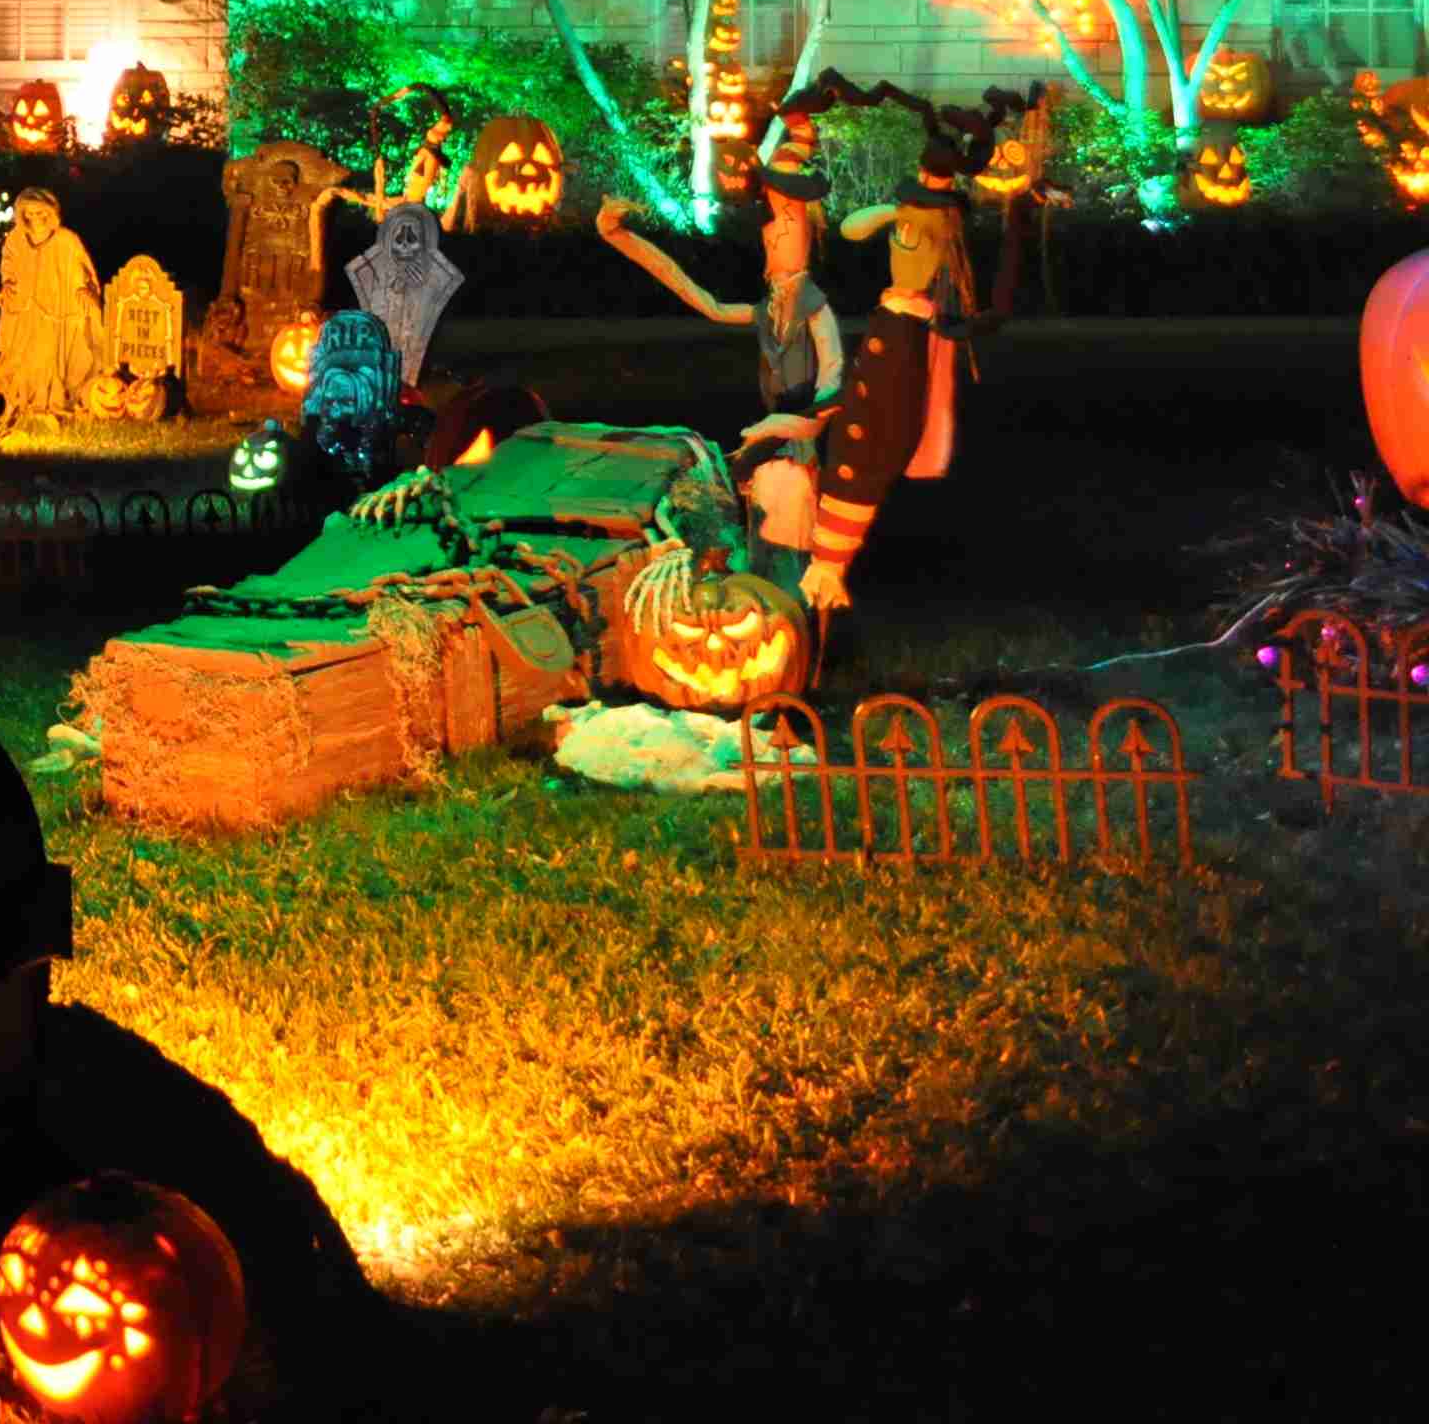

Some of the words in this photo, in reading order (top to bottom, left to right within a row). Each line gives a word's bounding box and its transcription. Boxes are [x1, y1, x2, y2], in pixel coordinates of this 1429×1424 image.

[126, 308, 160, 325] REST
[136, 326, 150, 339] IN
[325, 320, 373, 349] RIP
[122, 342, 167, 359] PIECES
